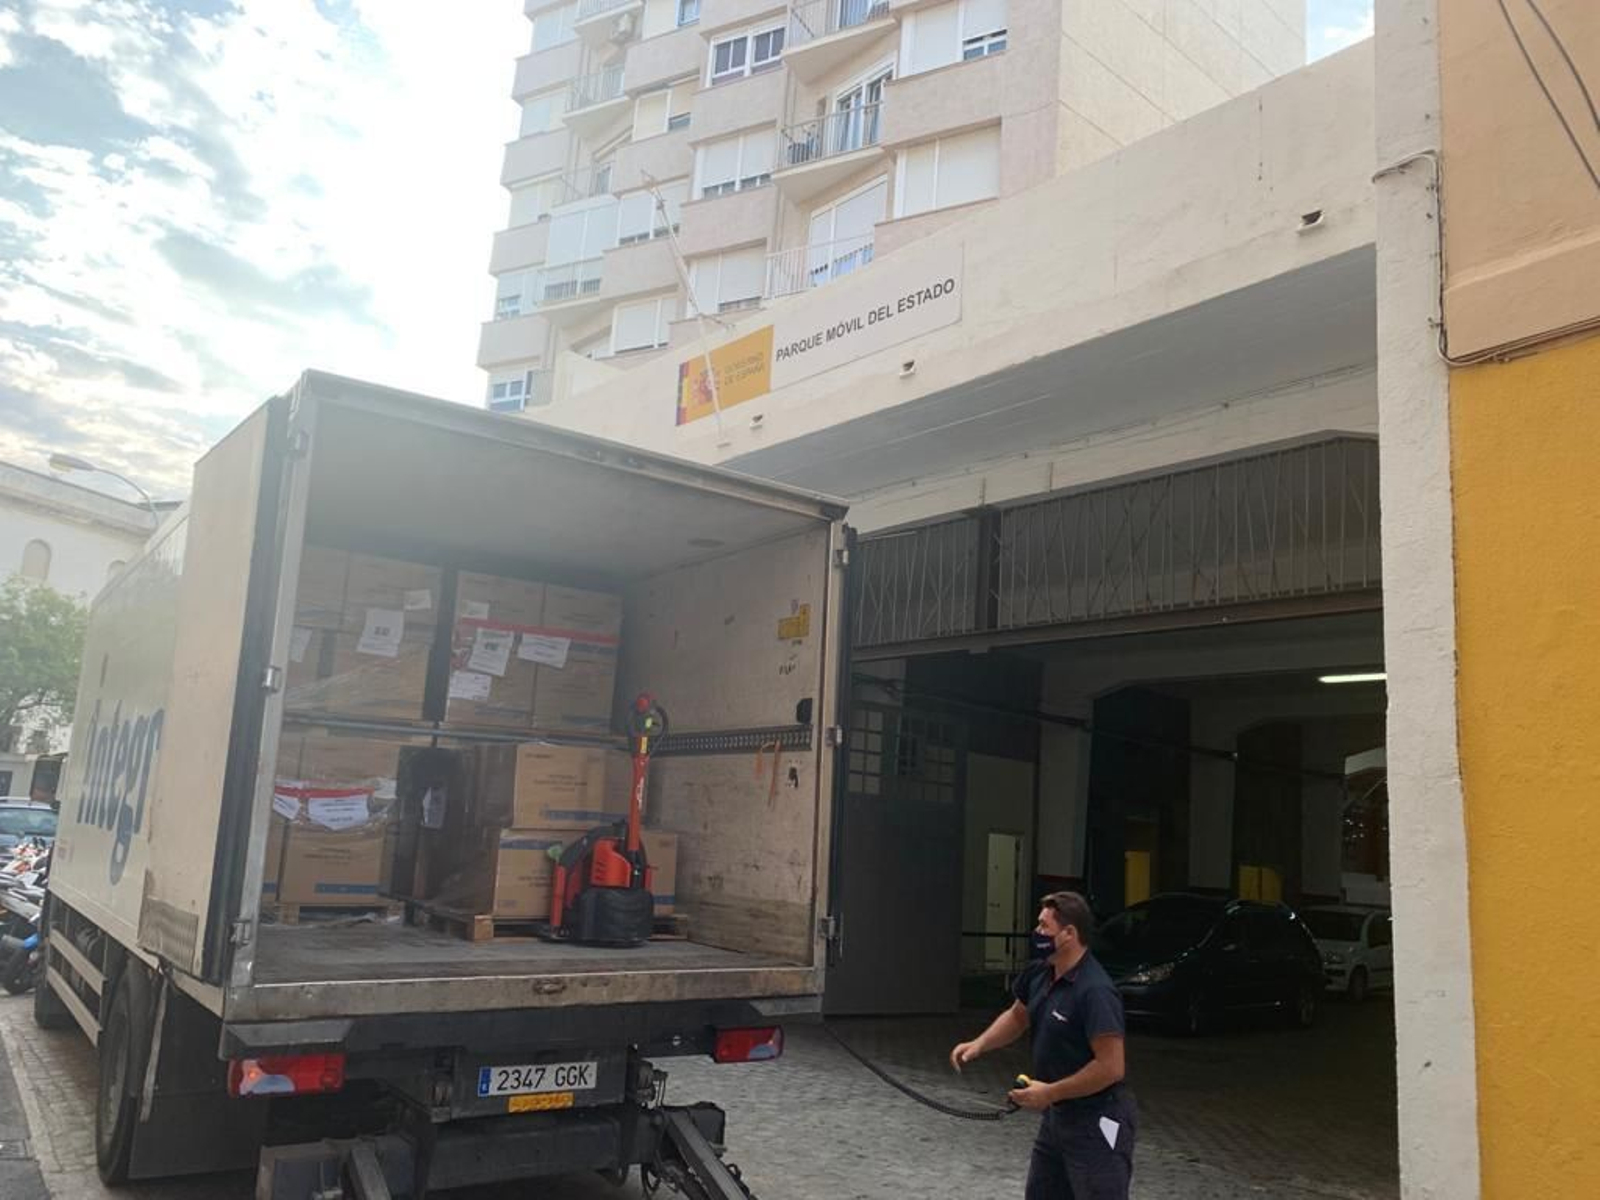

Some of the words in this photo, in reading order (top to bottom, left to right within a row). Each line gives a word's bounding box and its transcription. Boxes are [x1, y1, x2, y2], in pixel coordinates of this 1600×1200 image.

[775, 331, 824, 362] PARQUE
[825, 317, 865, 342] MÓVIL
[868, 304, 894, 325] DEL
[898, 278, 955, 313] ESTADO
[497, 1068, 546, 1091] 2347
[554, 1064, 590, 1087] GGK
